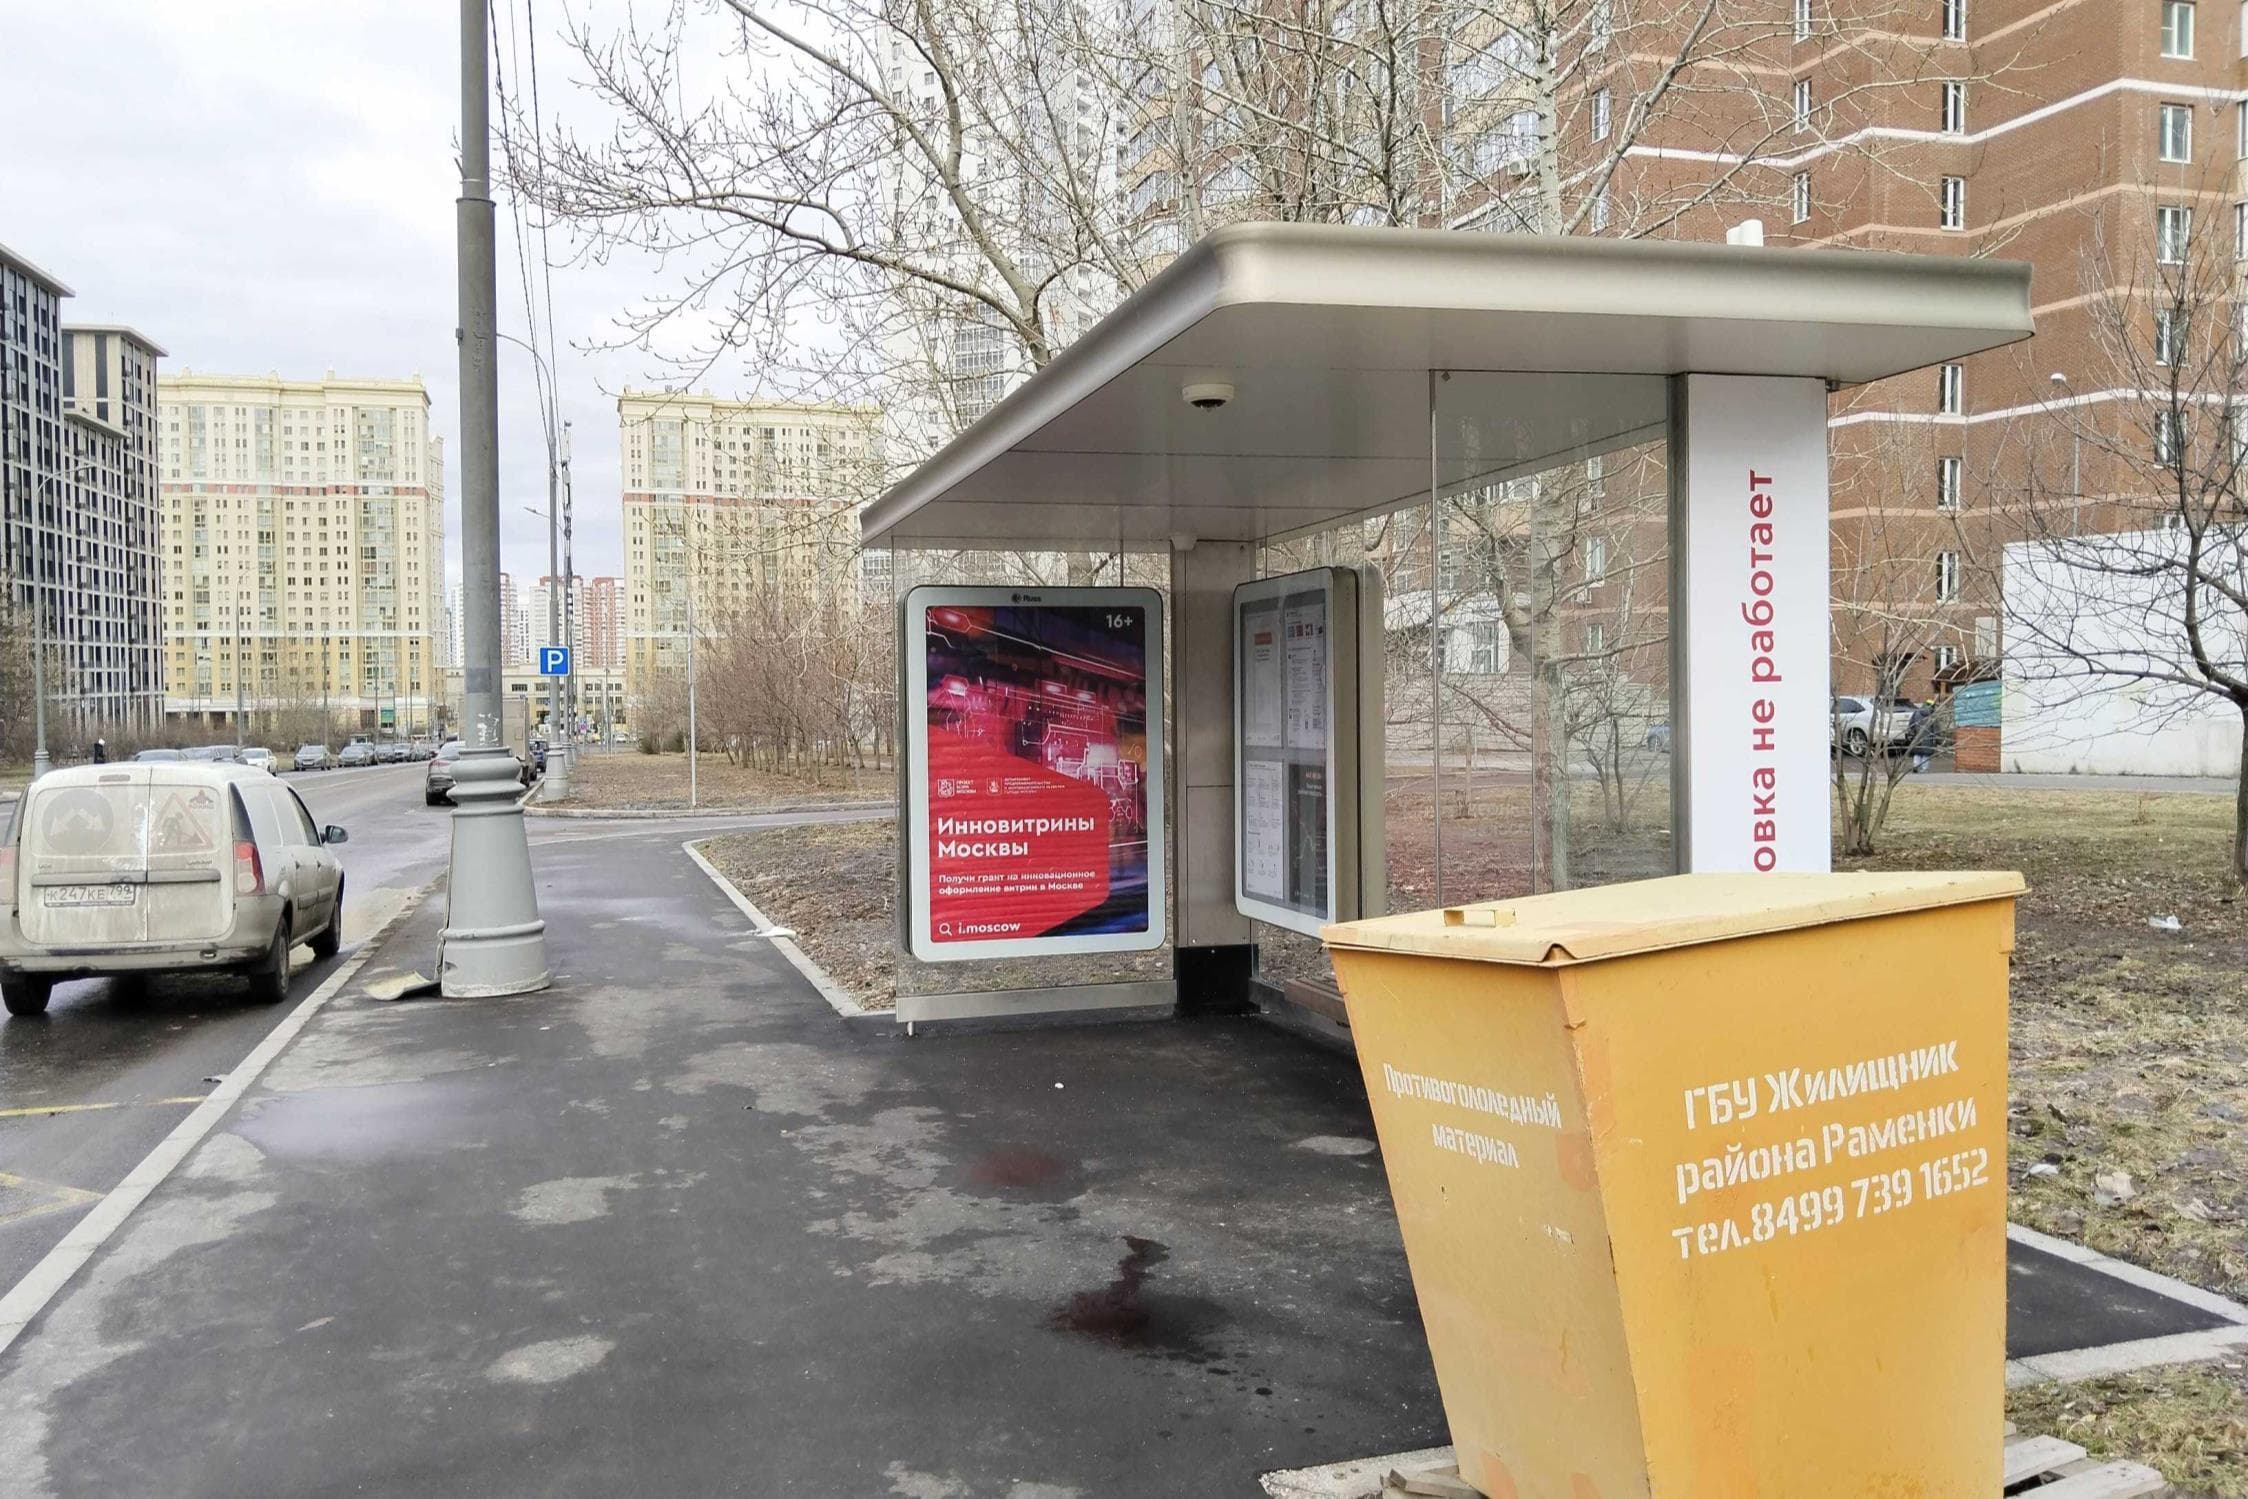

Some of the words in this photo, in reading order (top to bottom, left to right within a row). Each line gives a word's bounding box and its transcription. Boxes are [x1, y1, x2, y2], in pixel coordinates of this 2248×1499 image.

[1741, 469, 1782, 682] работает
[1106, 614, 1133, 628] 16+
[547, 649, 564, 673] P
[1751, 698, 1775, 751] не
[938, 816, 1095, 837] Инновитрины
[938, 839, 1028, 858] Москвы
[938, 874, 975, 884] Получи
[978, 874, 1004, 883] грант
[1021, 871, 1095, 881] инновационное
[938, 885, 1001, 895] оформление
[1003, 884, 1037, 894] витрин
[1048, 882, 1083, 891] Москве
[958, 922, 1020, 934] i.moscow
[1383, 1063, 1562, 1128] Противогололедный
[1683, 1077, 1758, 1130] ГБУ
[1764, 1040, 1959, 1113] Жилищник
[1676, 1138, 1816, 1204] района
[1822, 1097, 1977, 1164] Раменки
[1851, 1167, 1912, 1218] 739
[1919, 1147, 1989, 1199] 1652
